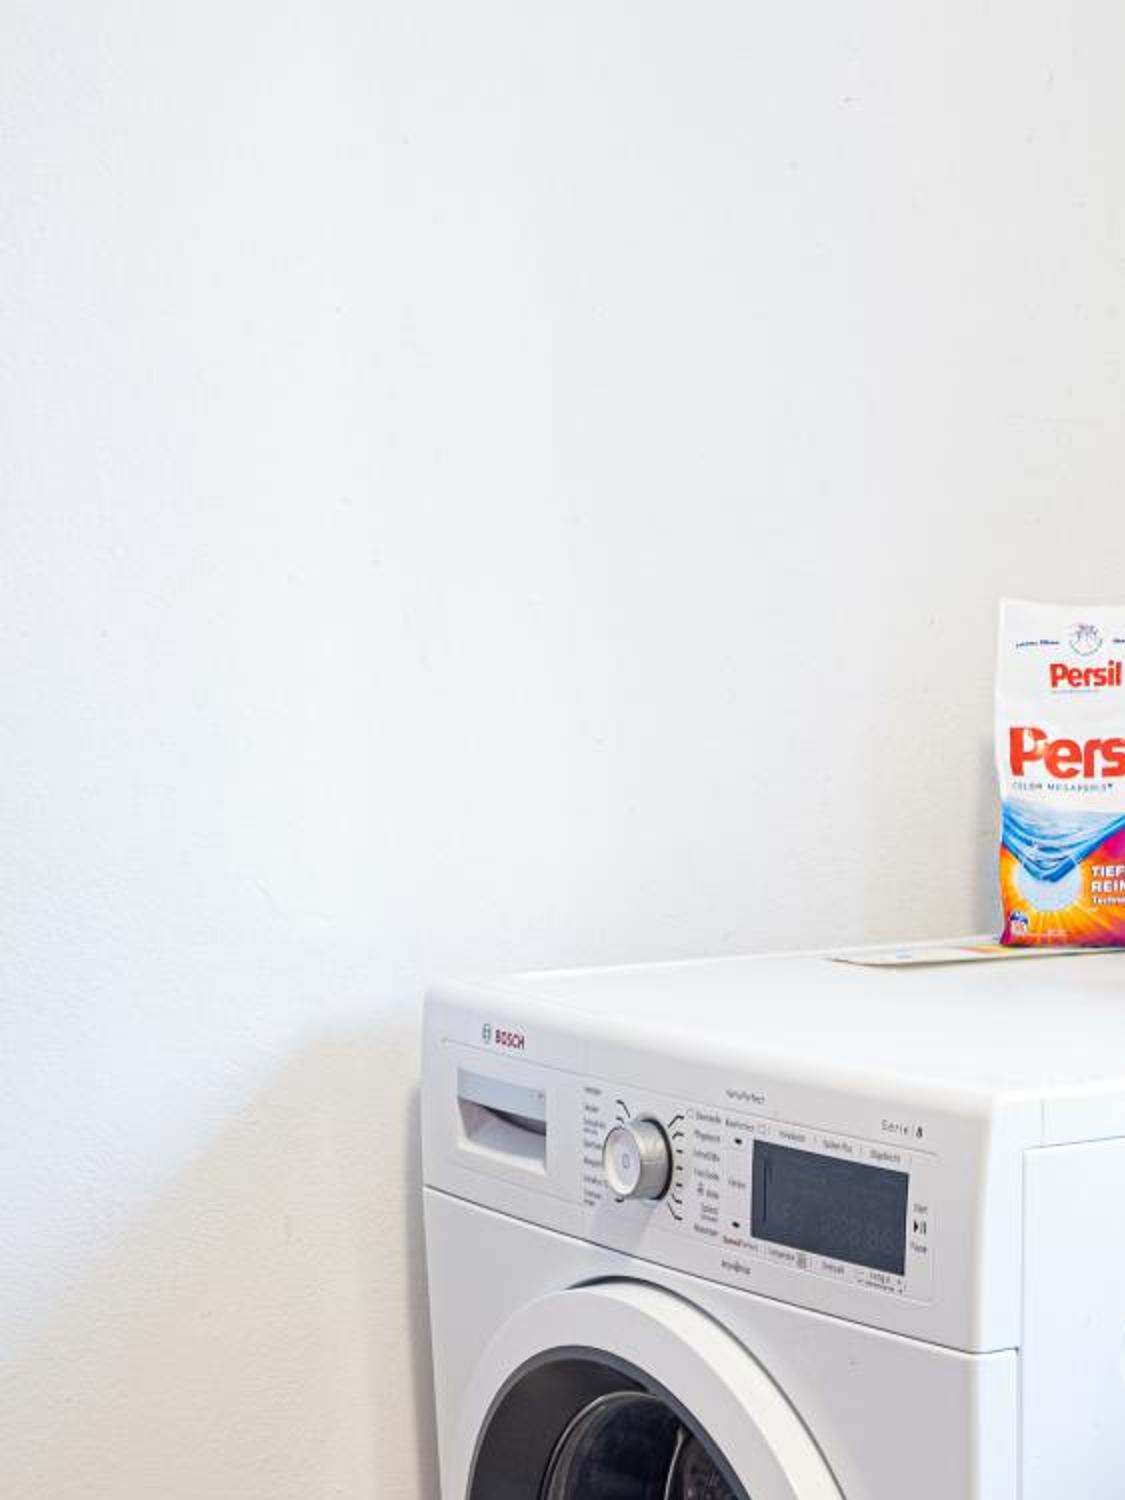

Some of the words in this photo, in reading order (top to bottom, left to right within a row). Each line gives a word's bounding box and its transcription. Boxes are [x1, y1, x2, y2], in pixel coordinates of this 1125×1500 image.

[1050, 660, 1122, 688] Persil
[495, 1029, 525, 1050] BOSCH
[881, 1119, 909, 1136] Serie
[915, 1126, 923, 1139] 8
